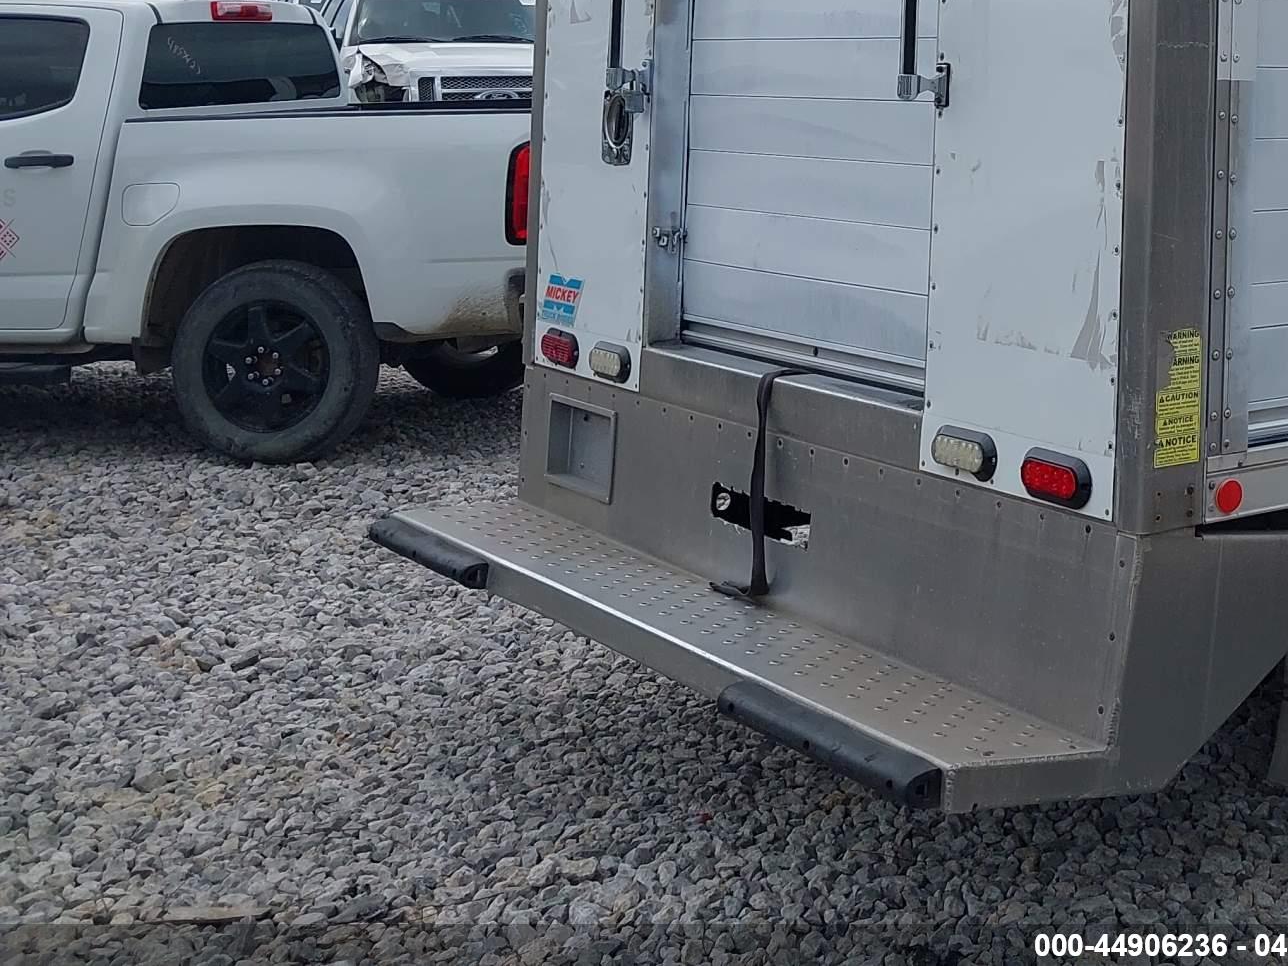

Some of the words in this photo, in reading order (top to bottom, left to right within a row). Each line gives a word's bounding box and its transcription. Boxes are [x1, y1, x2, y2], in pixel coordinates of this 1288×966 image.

[545, 285, 580, 304] MICKEY
[1172, 355, 1200, 366] ARNING
[1166, 391, 1199, 402] CAUTION
[1168, 416, 1194, 425] NOTICE
[1165, 435, 1197, 447] NOTICE
